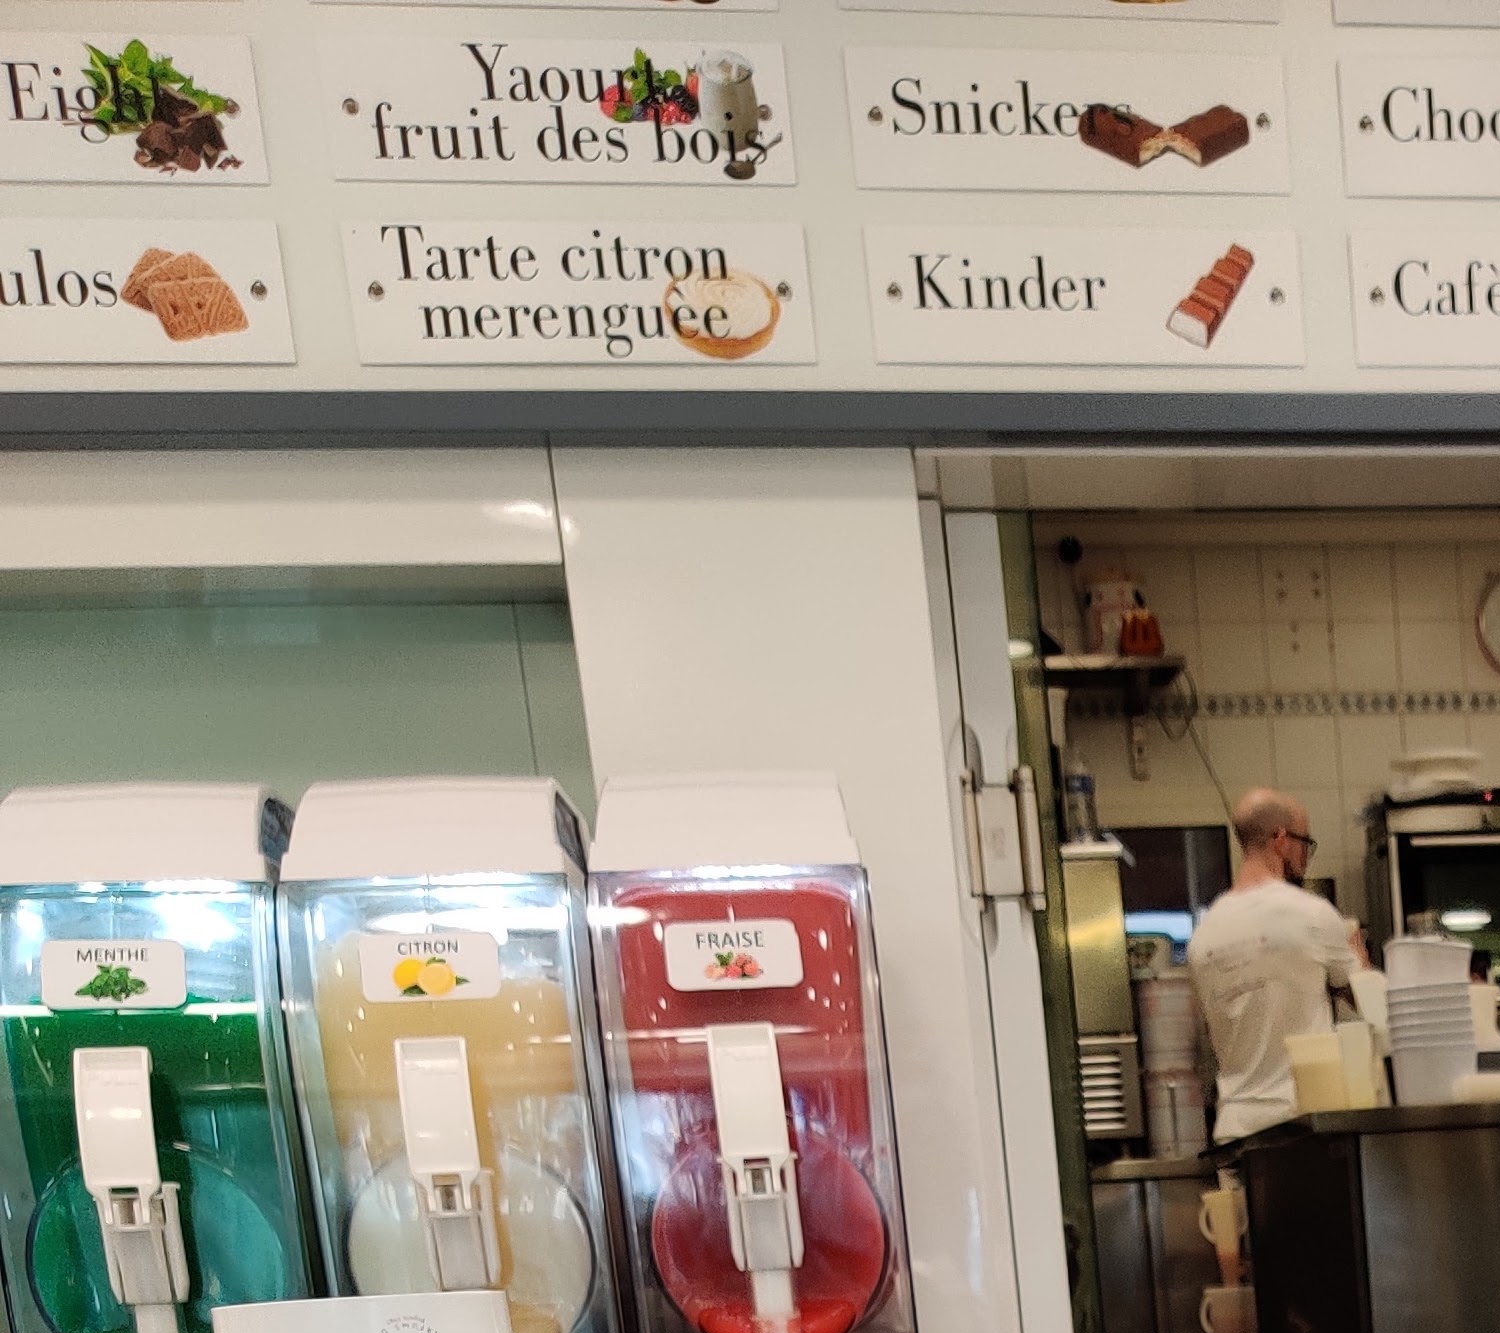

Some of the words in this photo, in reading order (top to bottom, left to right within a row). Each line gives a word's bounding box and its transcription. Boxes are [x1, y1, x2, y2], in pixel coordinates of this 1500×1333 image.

[370, 103, 516, 162] fruit
[536, 105, 629, 163] des
[653, 106, 770, 164] bois
[381, 224, 540, 284] Tarte
[561, 230, 731, 283] citron
[911, 253, 1107, 314] Kinder
[75, 946, 150, 965] MENTHE
[396, 938, 459, 957] CITRON
[695, 930, 765, 951] FRAISE
